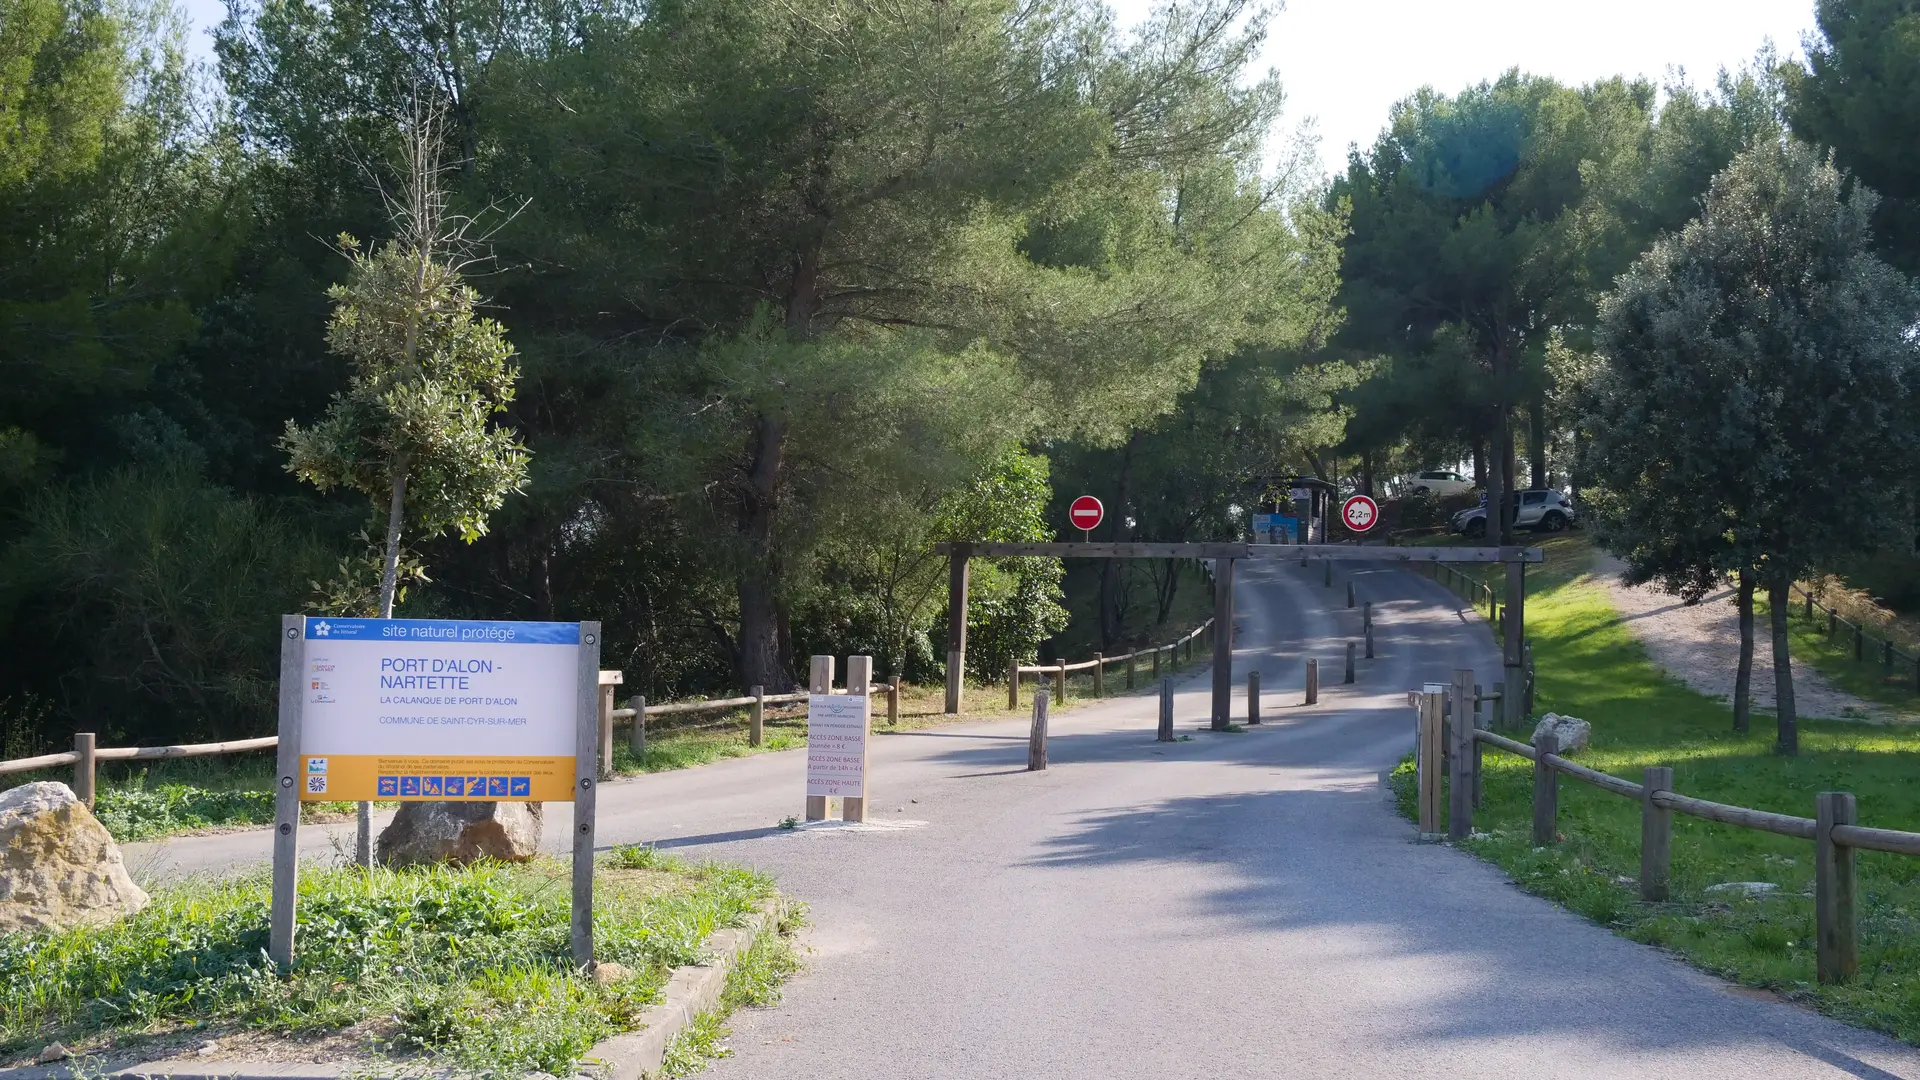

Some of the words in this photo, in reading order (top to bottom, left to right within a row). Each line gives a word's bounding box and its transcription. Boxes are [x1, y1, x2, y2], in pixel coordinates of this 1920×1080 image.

[382, 626, 406, 637] site
[411, 627, 458, 638] naturel
[462, 626, 515, 642] protégé
[381, 658, 428, 672] PORT
[432, 659, 492, 673] D'ALON
[380, 676, 469, 690] NARTETTE
[393, 697, 442, 705] CALANQUE
[444, 697, 457, 705] DE
[459, 697, 483, 706] PORT
[485, 697, 517, 706] D'ALON
[379, 716, 425, 725] COMMUNE
[427, 717, 438, 725] DE
[440, 717, 527, 726] SAINT-CYR-SUR-MER
[809, 742, 830, 750] Journée
